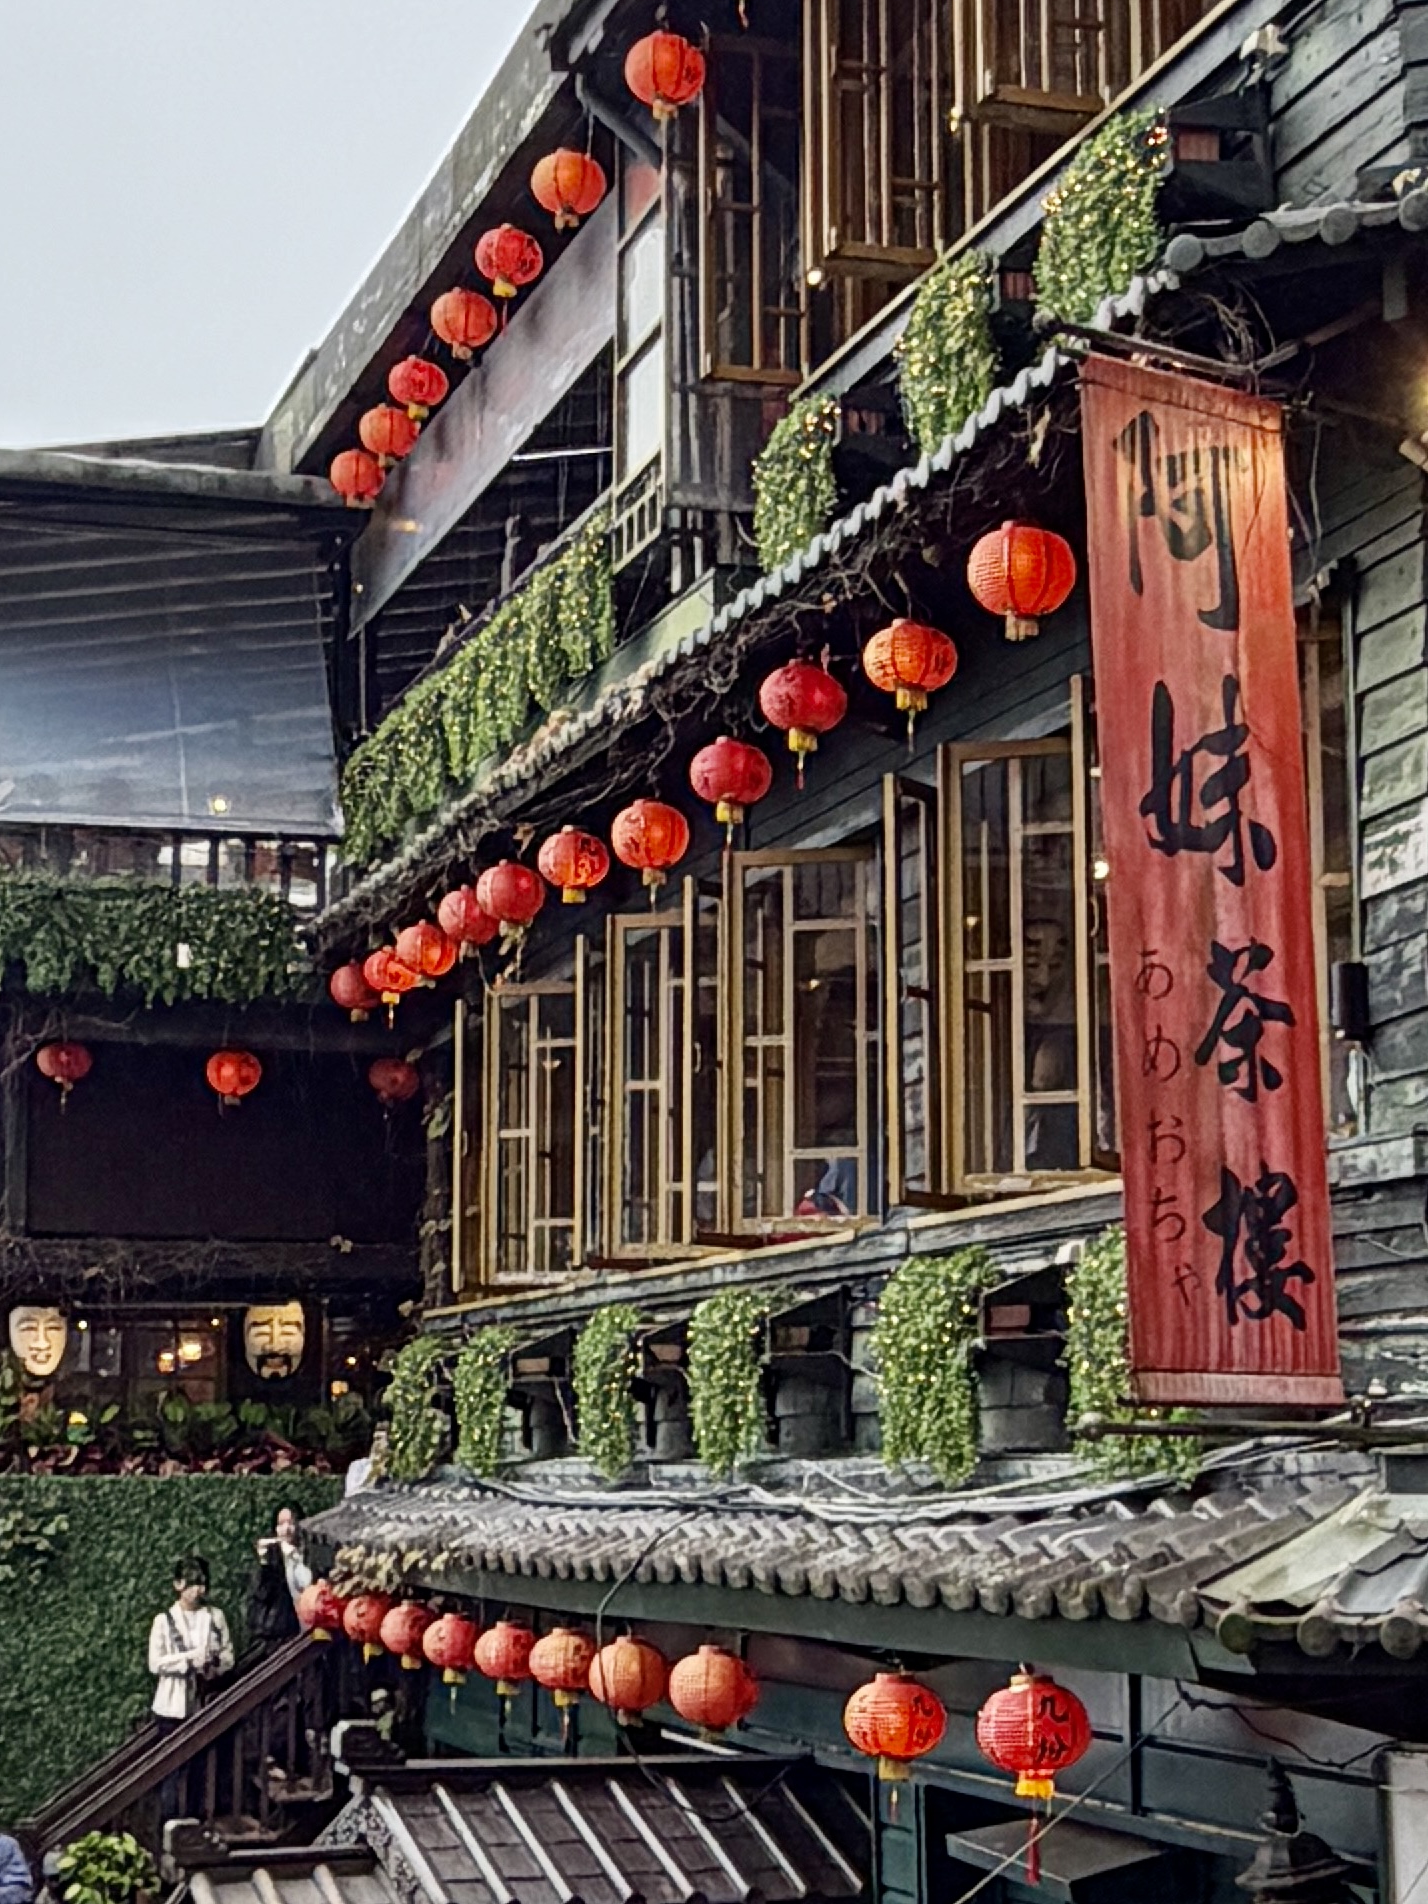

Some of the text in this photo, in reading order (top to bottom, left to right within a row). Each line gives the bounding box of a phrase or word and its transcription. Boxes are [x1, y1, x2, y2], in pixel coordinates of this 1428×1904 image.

[1113, 409, 1315, 1334] 阿妹茶樓
[1134, 944, 1204, 1311] あめおちゃ
[1037, 1695, 1073, 1765] 九份
